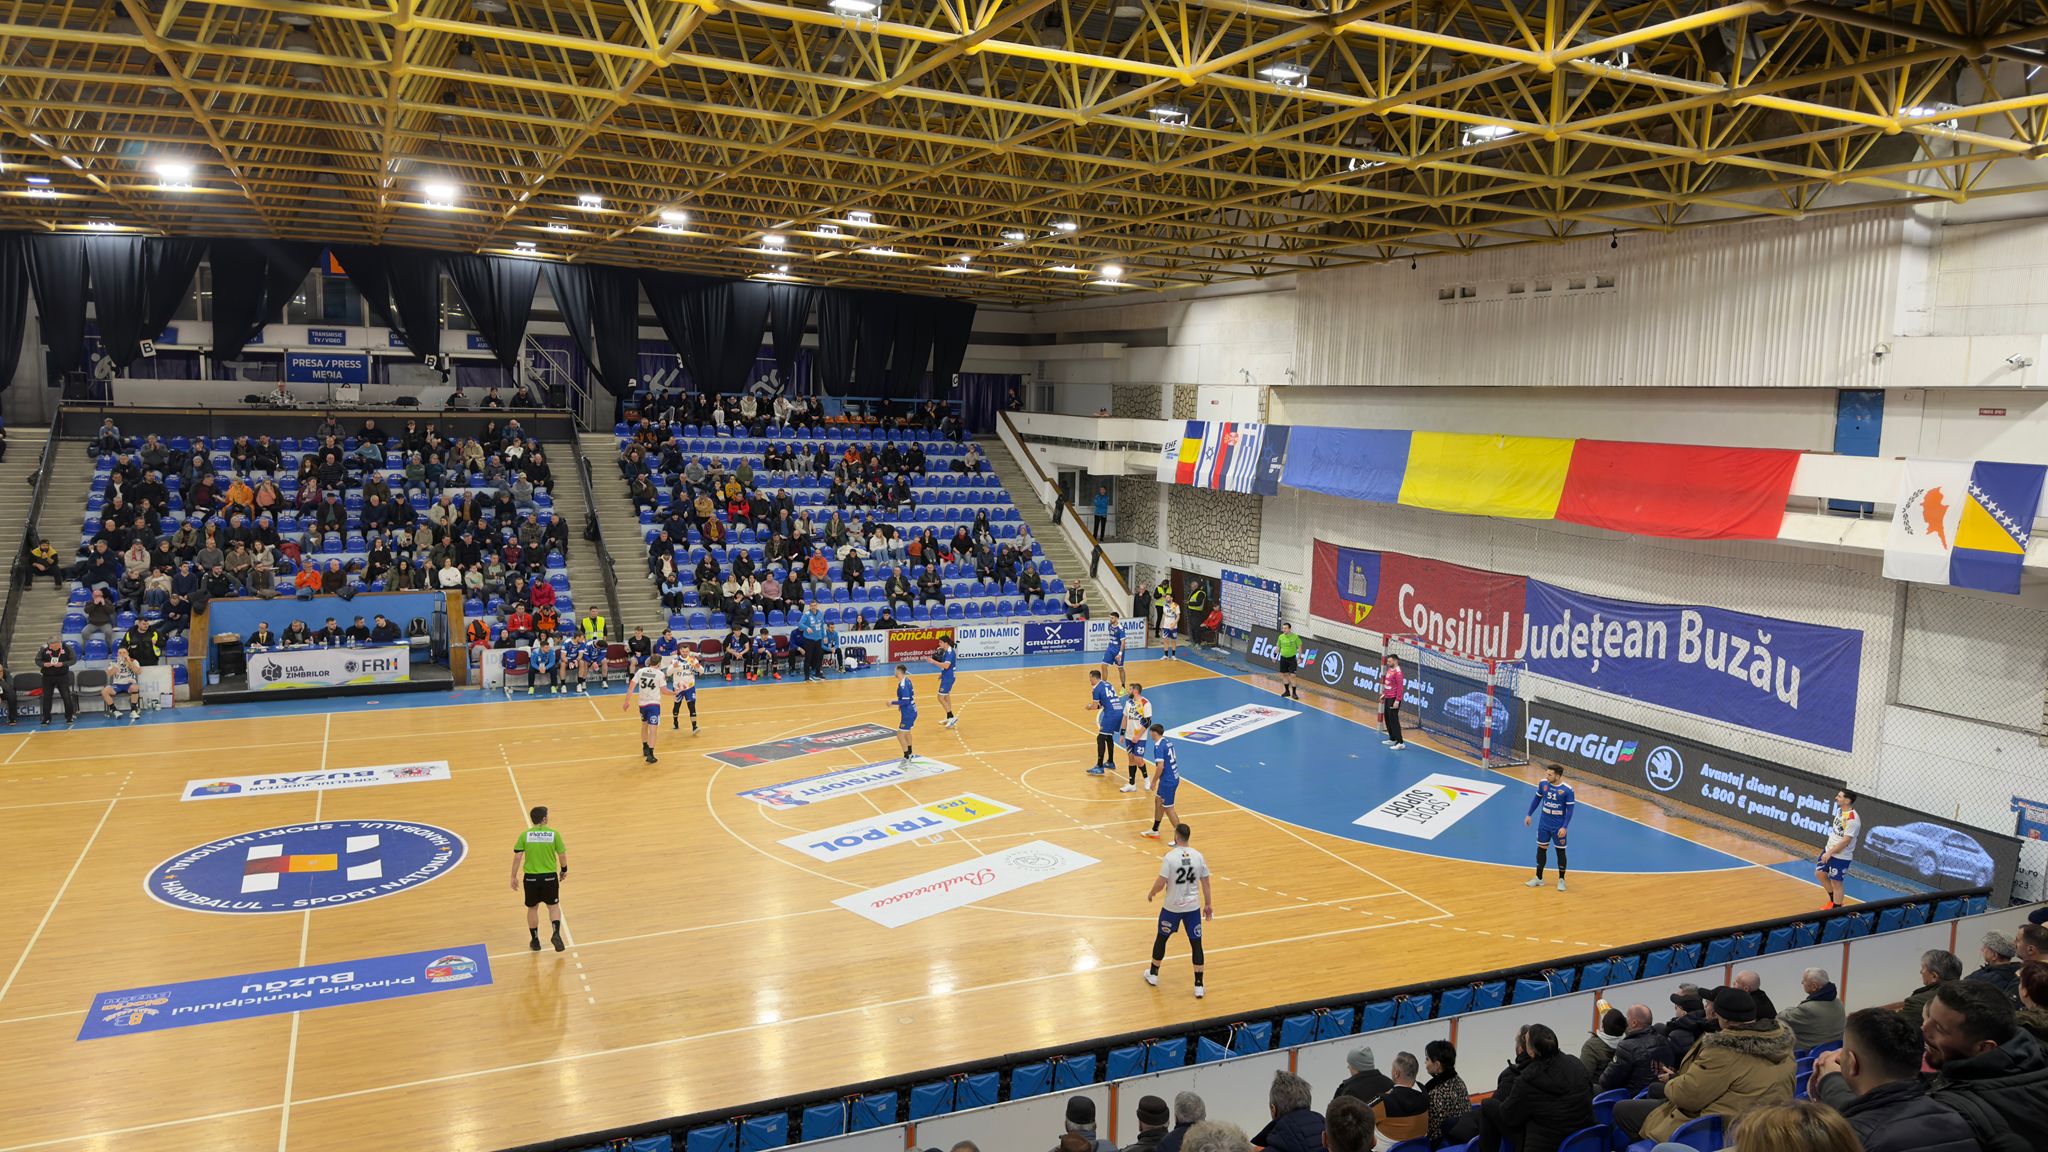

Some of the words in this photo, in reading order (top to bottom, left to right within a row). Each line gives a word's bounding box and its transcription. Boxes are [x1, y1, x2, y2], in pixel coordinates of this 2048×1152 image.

[143, 343, 153, 353] B
[292, 358, 324, 368] PRESA
[331, 359, 362, 369] PRESS
[312, 370, 343, 380] MEDIA
[959, 629, 977, 639] IDM
[979, 627, 1020, 638] DINAMIC
[1089, 622, 1105, 632] DM
[840, 633, 883, 645] DINAMIC
[1026, 638, 1081, 646] GRUNDFOS
[1398, 582, 1509, 660] Consiliul
[1514, 608, 1667, 674] Județean
[1677, 609, 1802, 711] Buzău
[286, 670, 330, 679] ZIMBRILOR
[640, 677, 656, 690] 34
[1353, 676, 1374, 691] 6.800
[1525, 717, 1625, 766] ElcarGid
[799, 769, 903, 796] PHYSIOFIT
[1701, 762, 1743, 791] Avantaj
[1746, 777, 1777, 799] client
[1779, 784, 1796, 803] de
[1797, 790, 1831, 815] până
[1379, 789, 1434, 818] SUPORT
[1546, 791, 1557, 800] 51
[1701, 783, 1735, 806] 6.800
[1737, 796, 1746, 809] €
[1747, 800, 1789, 823] pentru
[936, 799, 968, 811] TRS
[1402, 798, 1451, 825] SPORT
[257, 822, 334, 838] SPORT
[358, 821, 452, 847] HANDBALUL
[1175, 866, 1196, 885] 24
[160, 879, 264, 910] HANDBALUL
[291, 887, 377, 908] SPORT
[241, 971, 355, 997] Buzău
[319, 976, 416, 997] Primăria
[171, 991, 313, 1016] Municipiului
